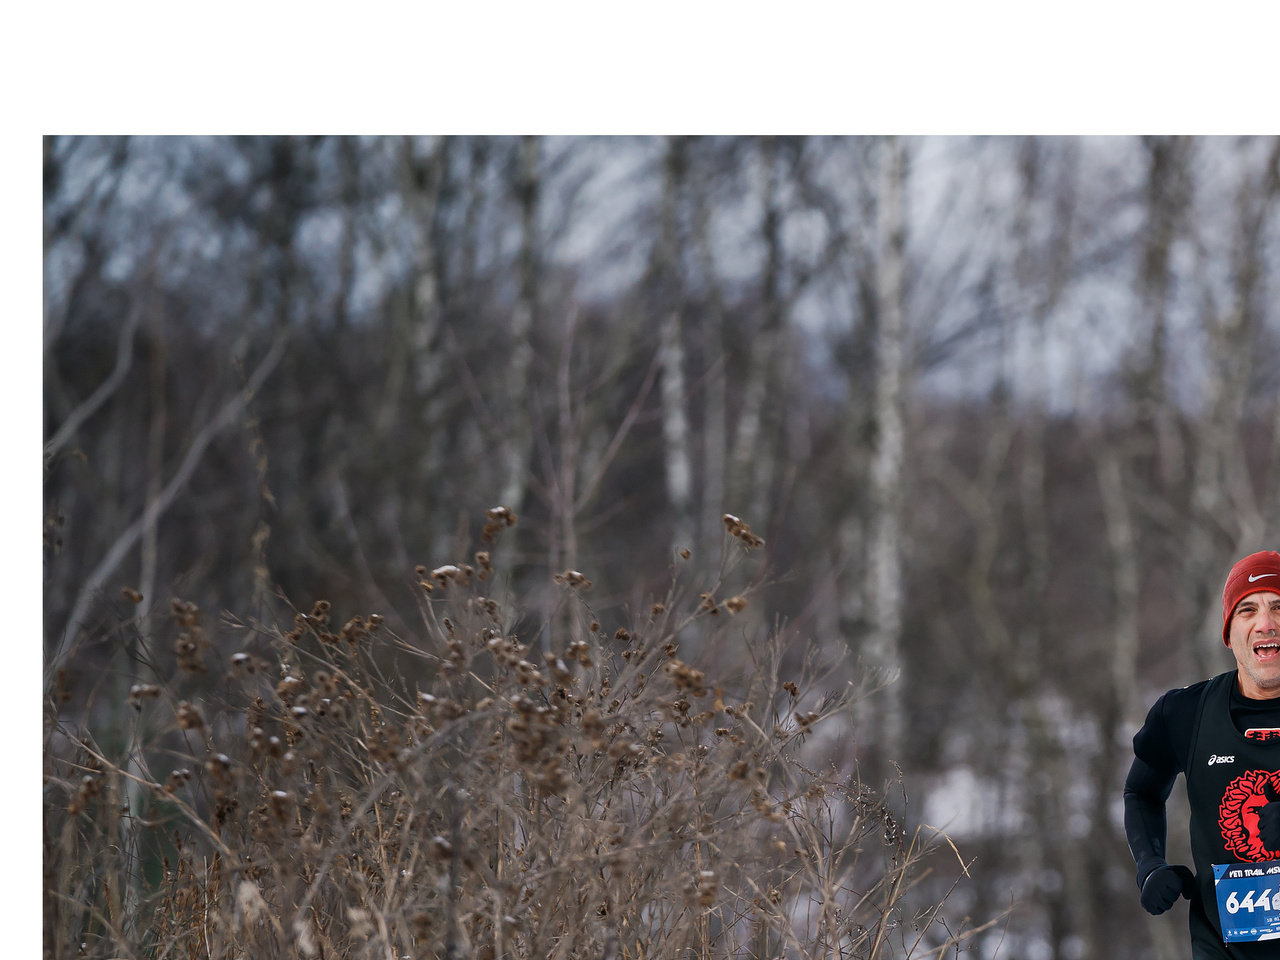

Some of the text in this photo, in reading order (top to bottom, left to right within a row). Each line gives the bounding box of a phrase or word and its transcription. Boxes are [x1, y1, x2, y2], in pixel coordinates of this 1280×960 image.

[1229, 869, 1243, 878] YETI
[1244, 868, 1265, 877] TRAIL
[1226, 889, 1271, 914] 644
